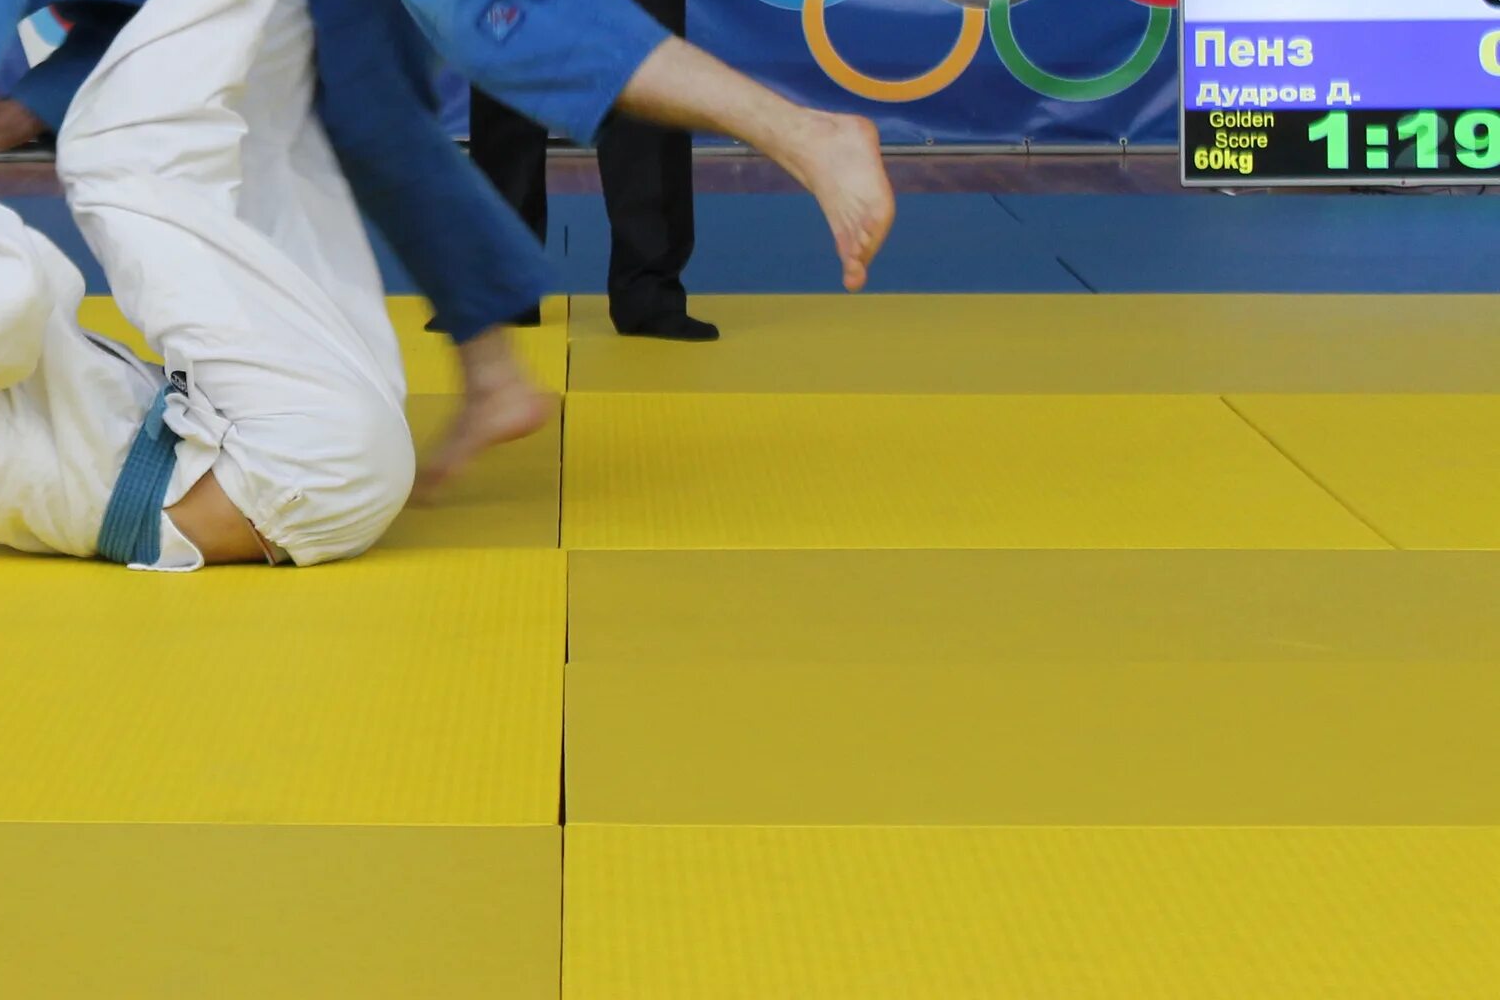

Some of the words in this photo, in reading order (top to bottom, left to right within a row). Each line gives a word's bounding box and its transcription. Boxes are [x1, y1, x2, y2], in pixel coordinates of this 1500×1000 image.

[1194, 29, 1314, 68] Пенз
[1195, 81, 1317, 108] Дудров
[1326, 79, 1361, 106] Д.
[1208, 110, 1275, 128] Golden
[1214, 132, 1269, 149] Score
[1194, 149, 1254, 174] 60kg
